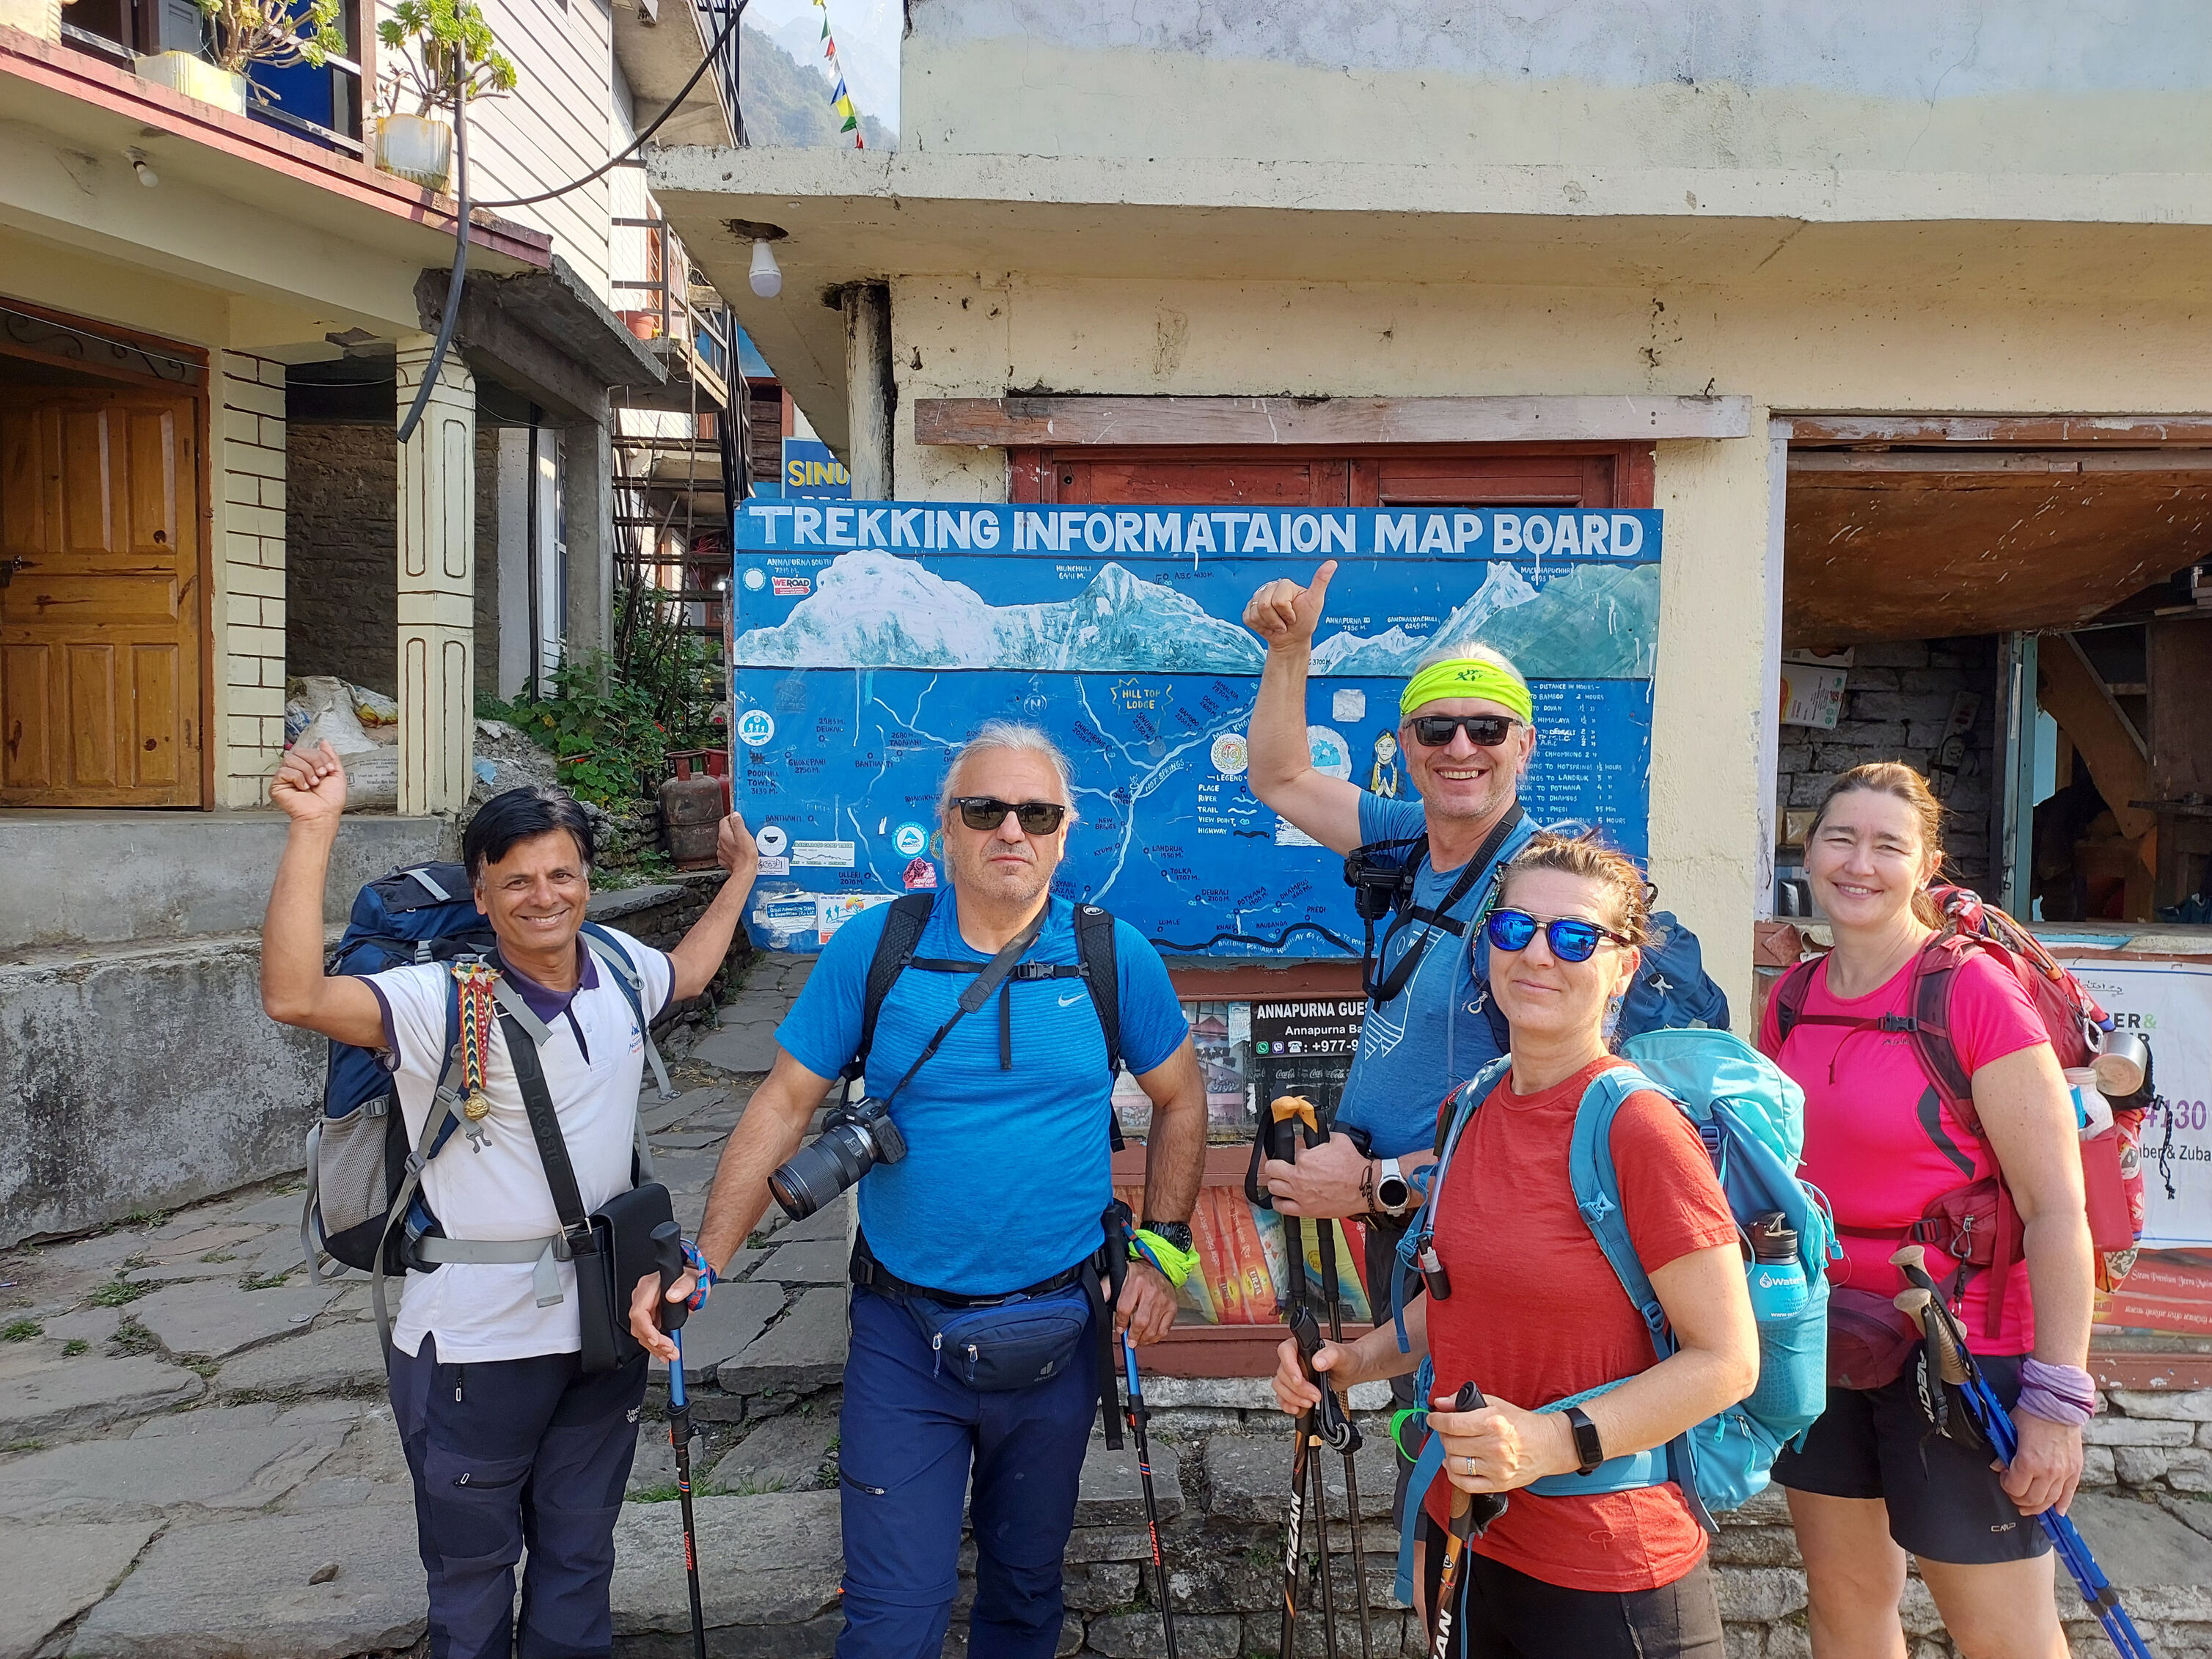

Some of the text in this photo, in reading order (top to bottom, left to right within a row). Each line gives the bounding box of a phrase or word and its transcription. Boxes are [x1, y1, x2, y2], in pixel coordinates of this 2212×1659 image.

[749, 505, 1644, 557] TREKKING INFORMATAION MAP BOARD
[767, 558, 810, 566] ANNAPURNA
[1122, 689, 1161, 699] HILL TOP
[1127, 700, 1155, 709] LODGE
[747, 779, 777, 788] TOWER
[1145, 758, 1185, 792] HOT SPRINGS
[1198, 794, 1217, 802] RIVER
[1237, 886, 1267, 907] POTHANA
[1280, 878, 1310, 901] DHAMPUS
[1246, 942, 1274, 953] POKHARA
[1277, 932, 1305, 954] HIGHWAY
[1256, 1002, 1336, 1019] ANNAPURNA
[1285, 1024, 1363, 1037] Annapurna Ba
[1312, 1039, 1358, 1053] +977-9
[530, 1094, 560, 1165] LACOSTE
[2167, 1144, 2176, 1160] &
[2179, 1145, 2212, 1162] Zuba
[1286, 1487, 1301, 1576] FIZAN
[1991, 1522, 2016, 1532] CMP
[684, 1531, 692, 1570] VIKING
[1149, 1520, 1160, 1567] VIKING
